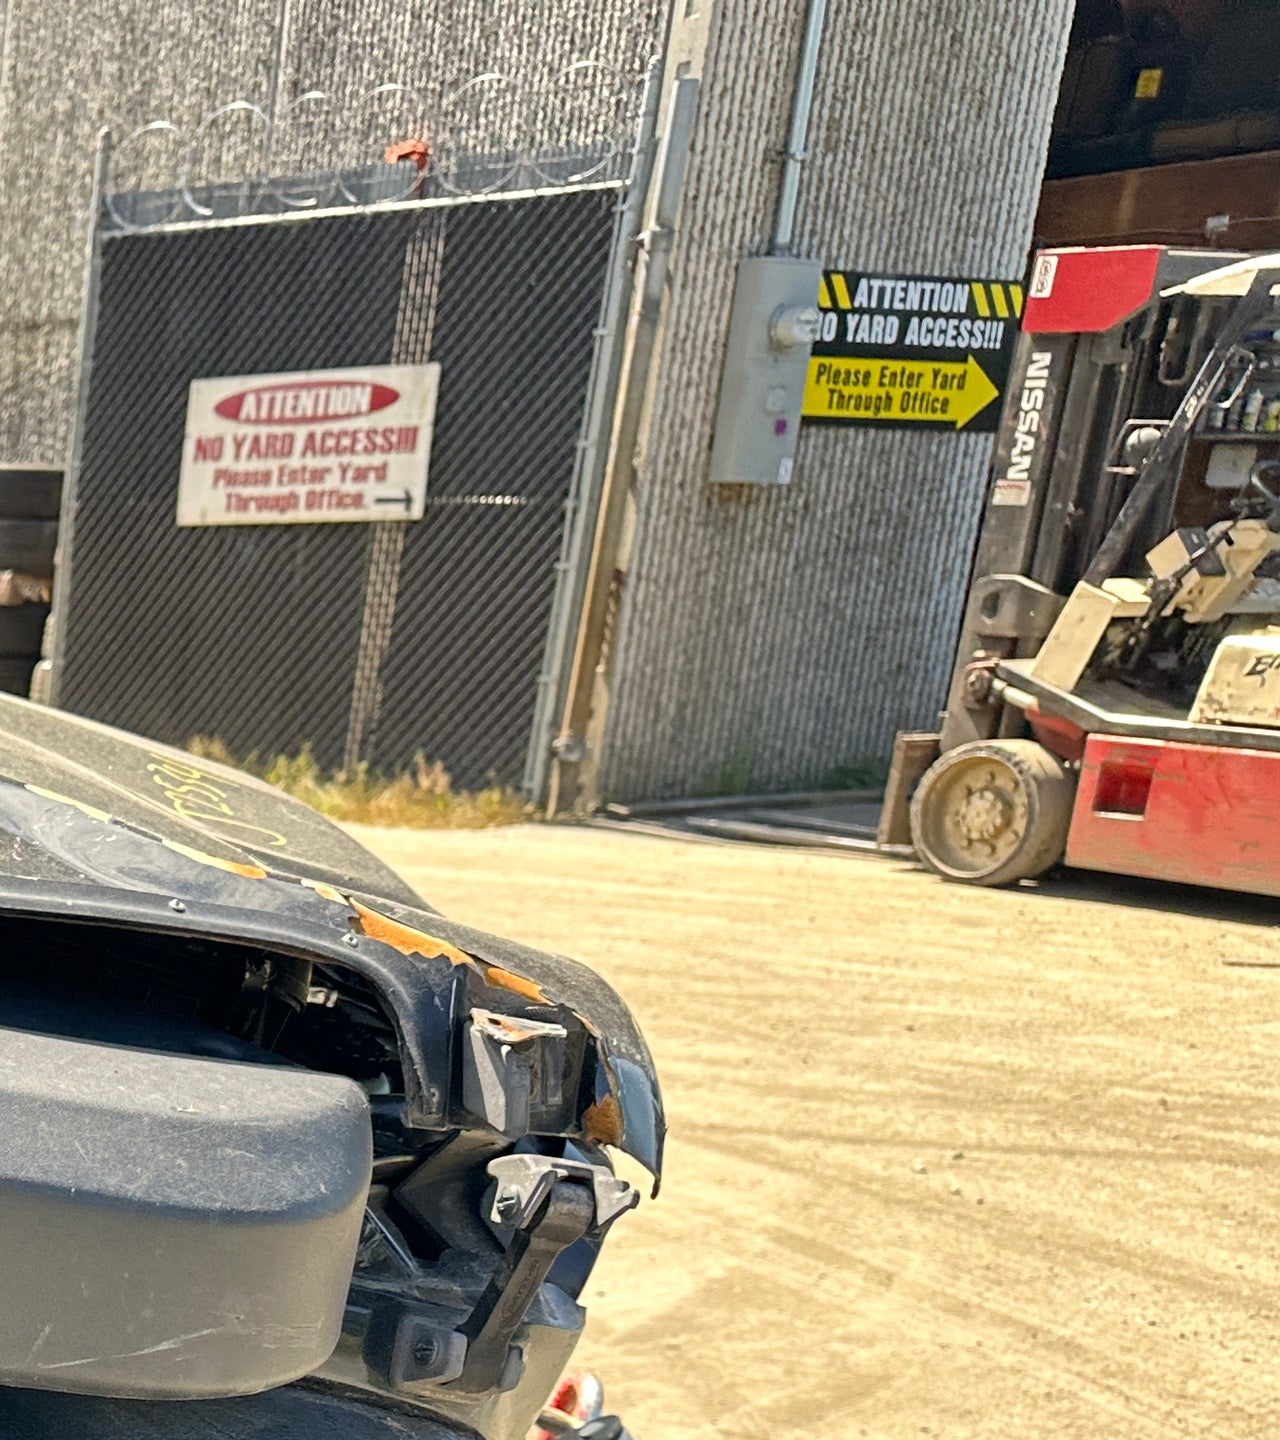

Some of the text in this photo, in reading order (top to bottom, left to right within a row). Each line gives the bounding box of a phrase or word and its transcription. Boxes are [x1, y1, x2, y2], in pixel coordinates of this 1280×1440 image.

[853, 278, 969, 313] ATTENTION
[846, 313, 899, 345] YARD
[904, 316, 1004, 350] ACCESS!!!
[815, 363, 968, 391] Please Enter Yard
[239, 384, 372, 422] ATTENTION
[827, 389, 950, 415] Through Office
[1007, 351, 1052, 481] NISSAN
[194, 426, 419, 463] NO YARD ACCESS!!!
[212, 460, 389, 488] Please Enter Yard
[225, 490, 300, 513] Through
